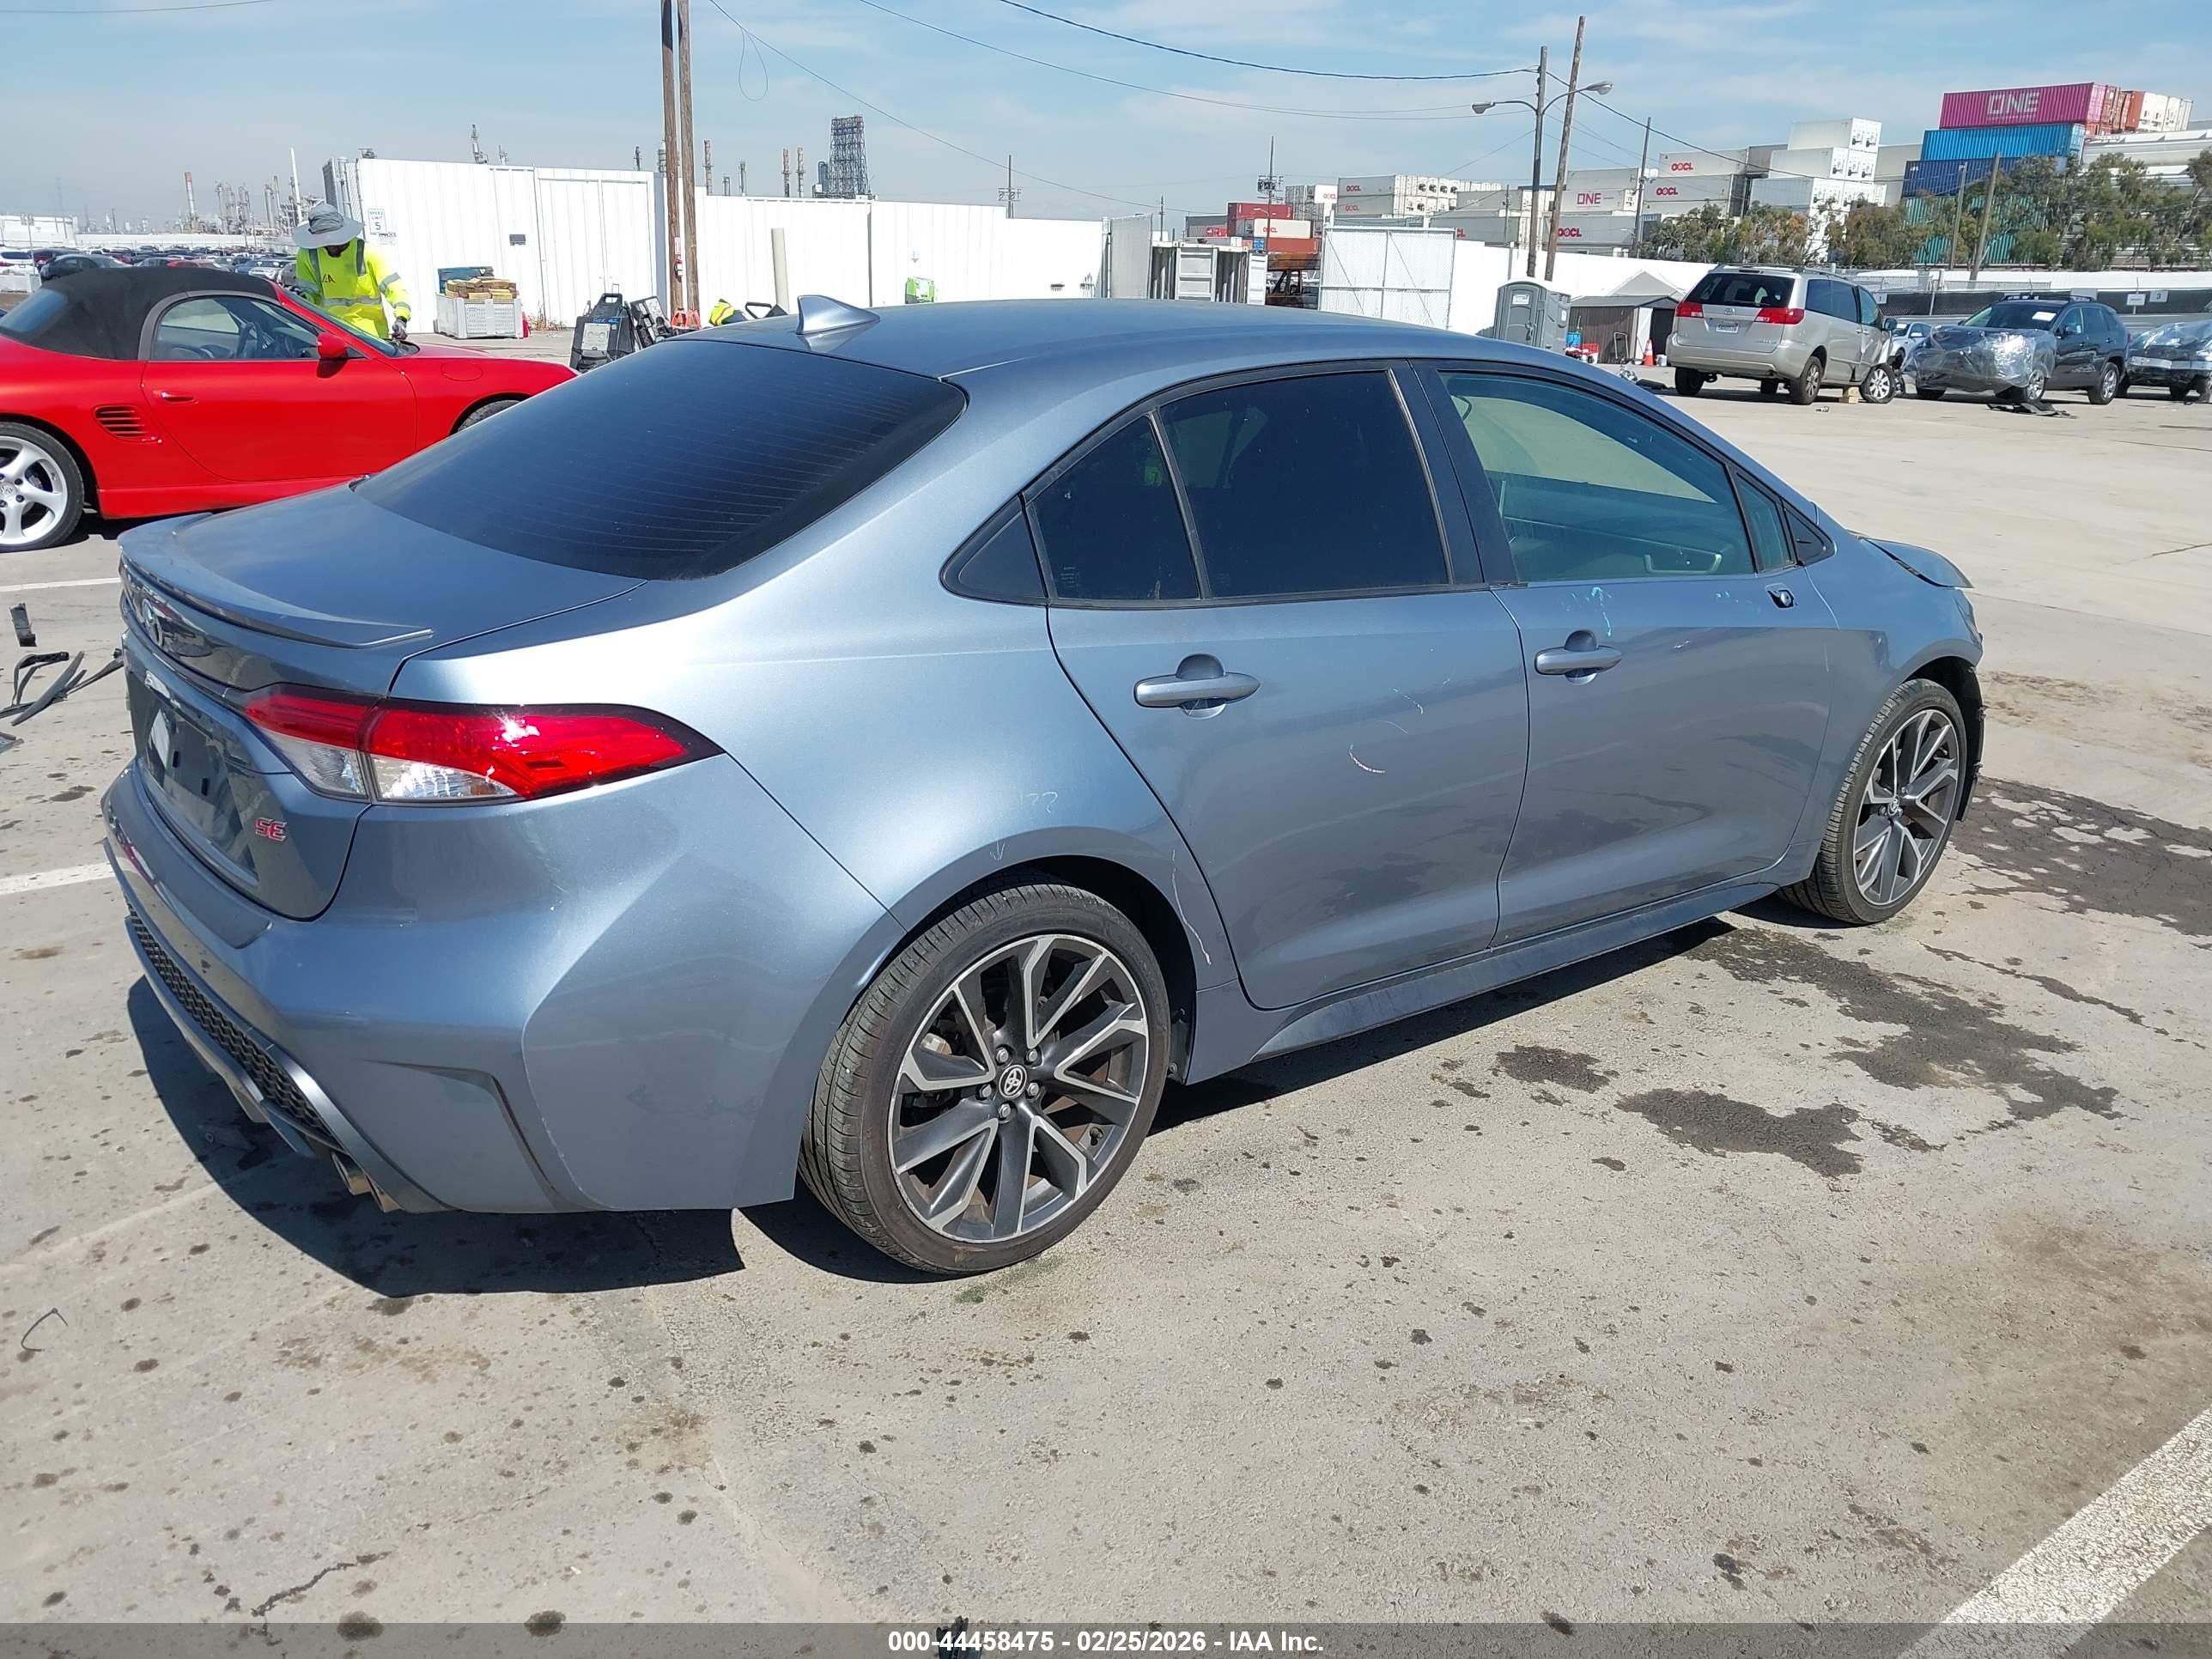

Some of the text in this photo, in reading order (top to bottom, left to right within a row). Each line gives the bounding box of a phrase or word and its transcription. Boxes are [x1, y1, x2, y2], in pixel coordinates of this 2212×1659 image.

[1987, 91, 2039, 114] ONE
[1671, 162, 1693, 171] OOCL
[1577, 192, 1601, 204] ONE
[374, 222, 381, 230] 5
[255, 817, 288, 842] SE
